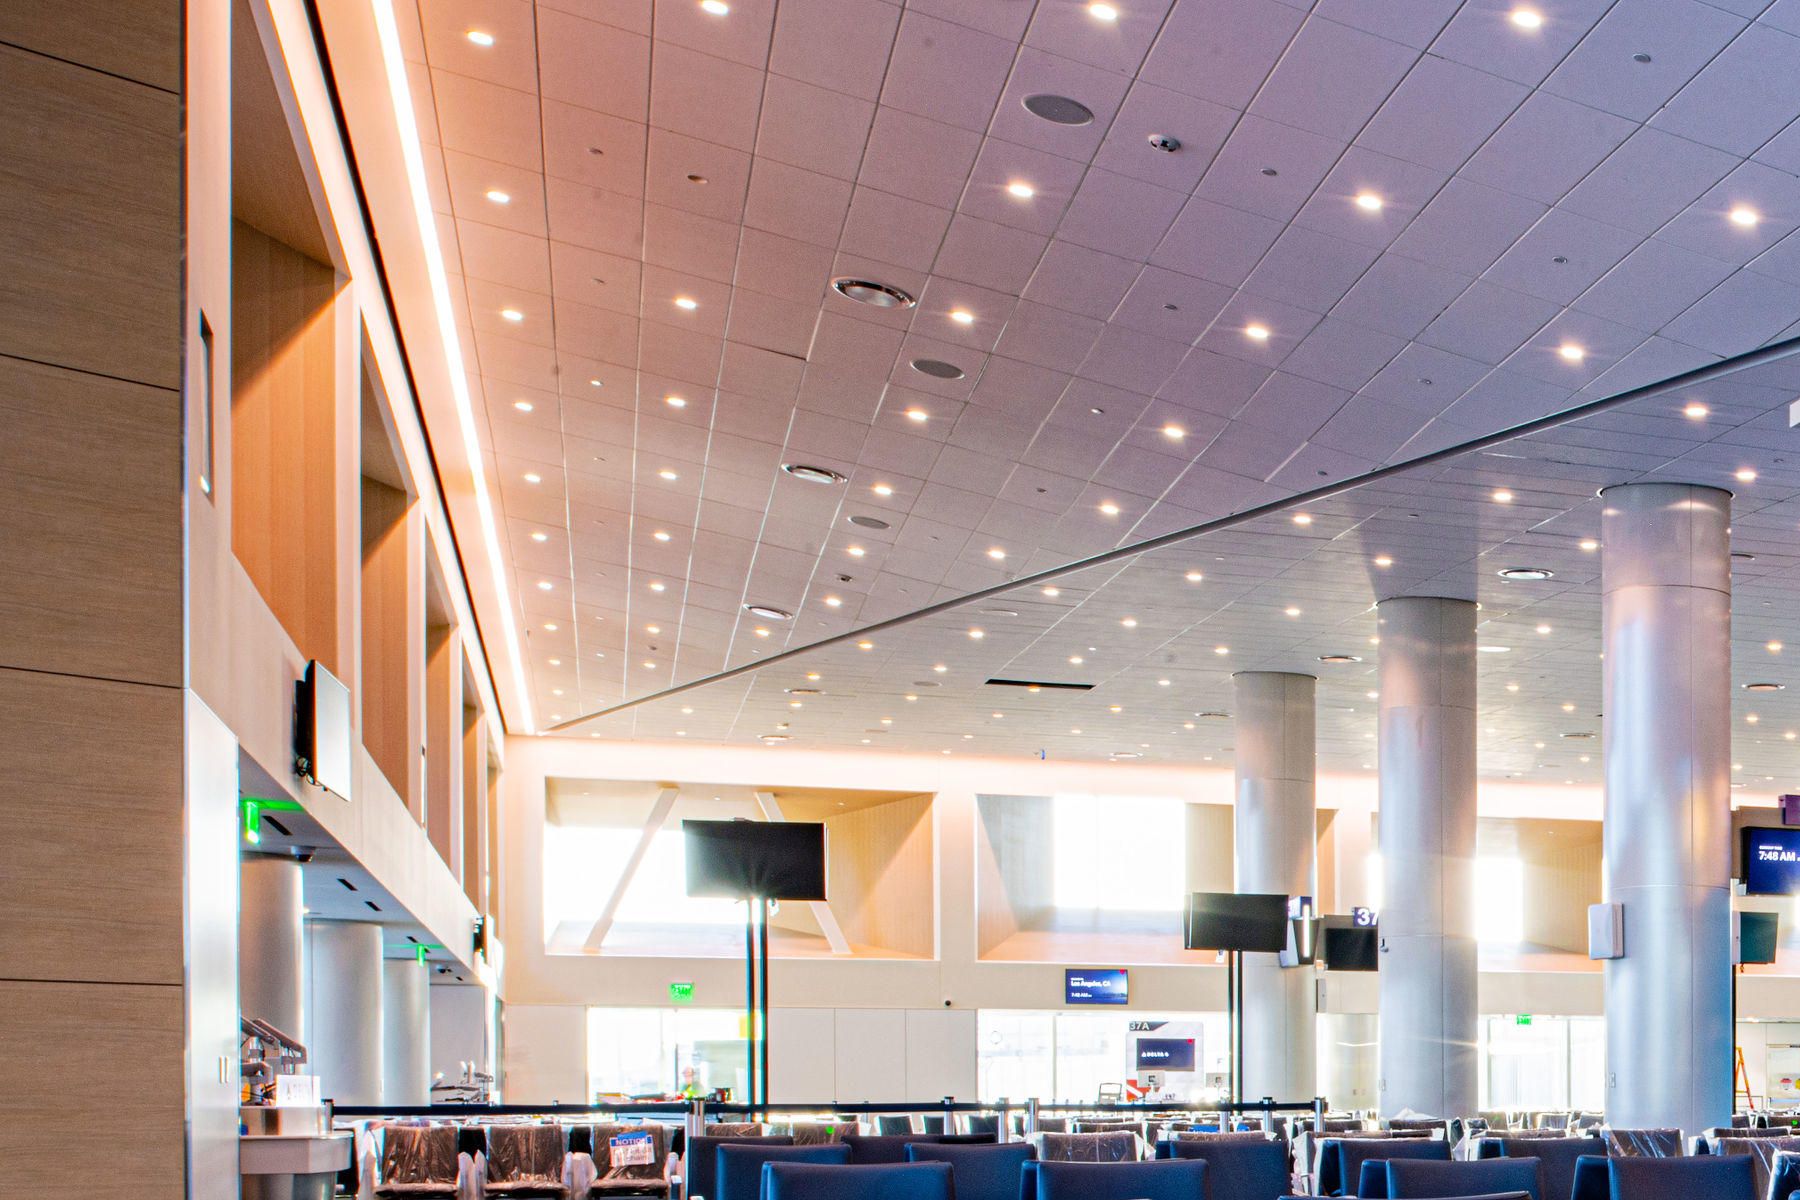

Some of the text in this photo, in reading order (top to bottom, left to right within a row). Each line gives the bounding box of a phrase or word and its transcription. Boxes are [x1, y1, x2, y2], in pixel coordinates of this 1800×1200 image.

[1758, 851, 1778, 861] 7:48
[1780, 852, 1795, 862] AM
[1130, 1022, 1149, 1031] 37A
